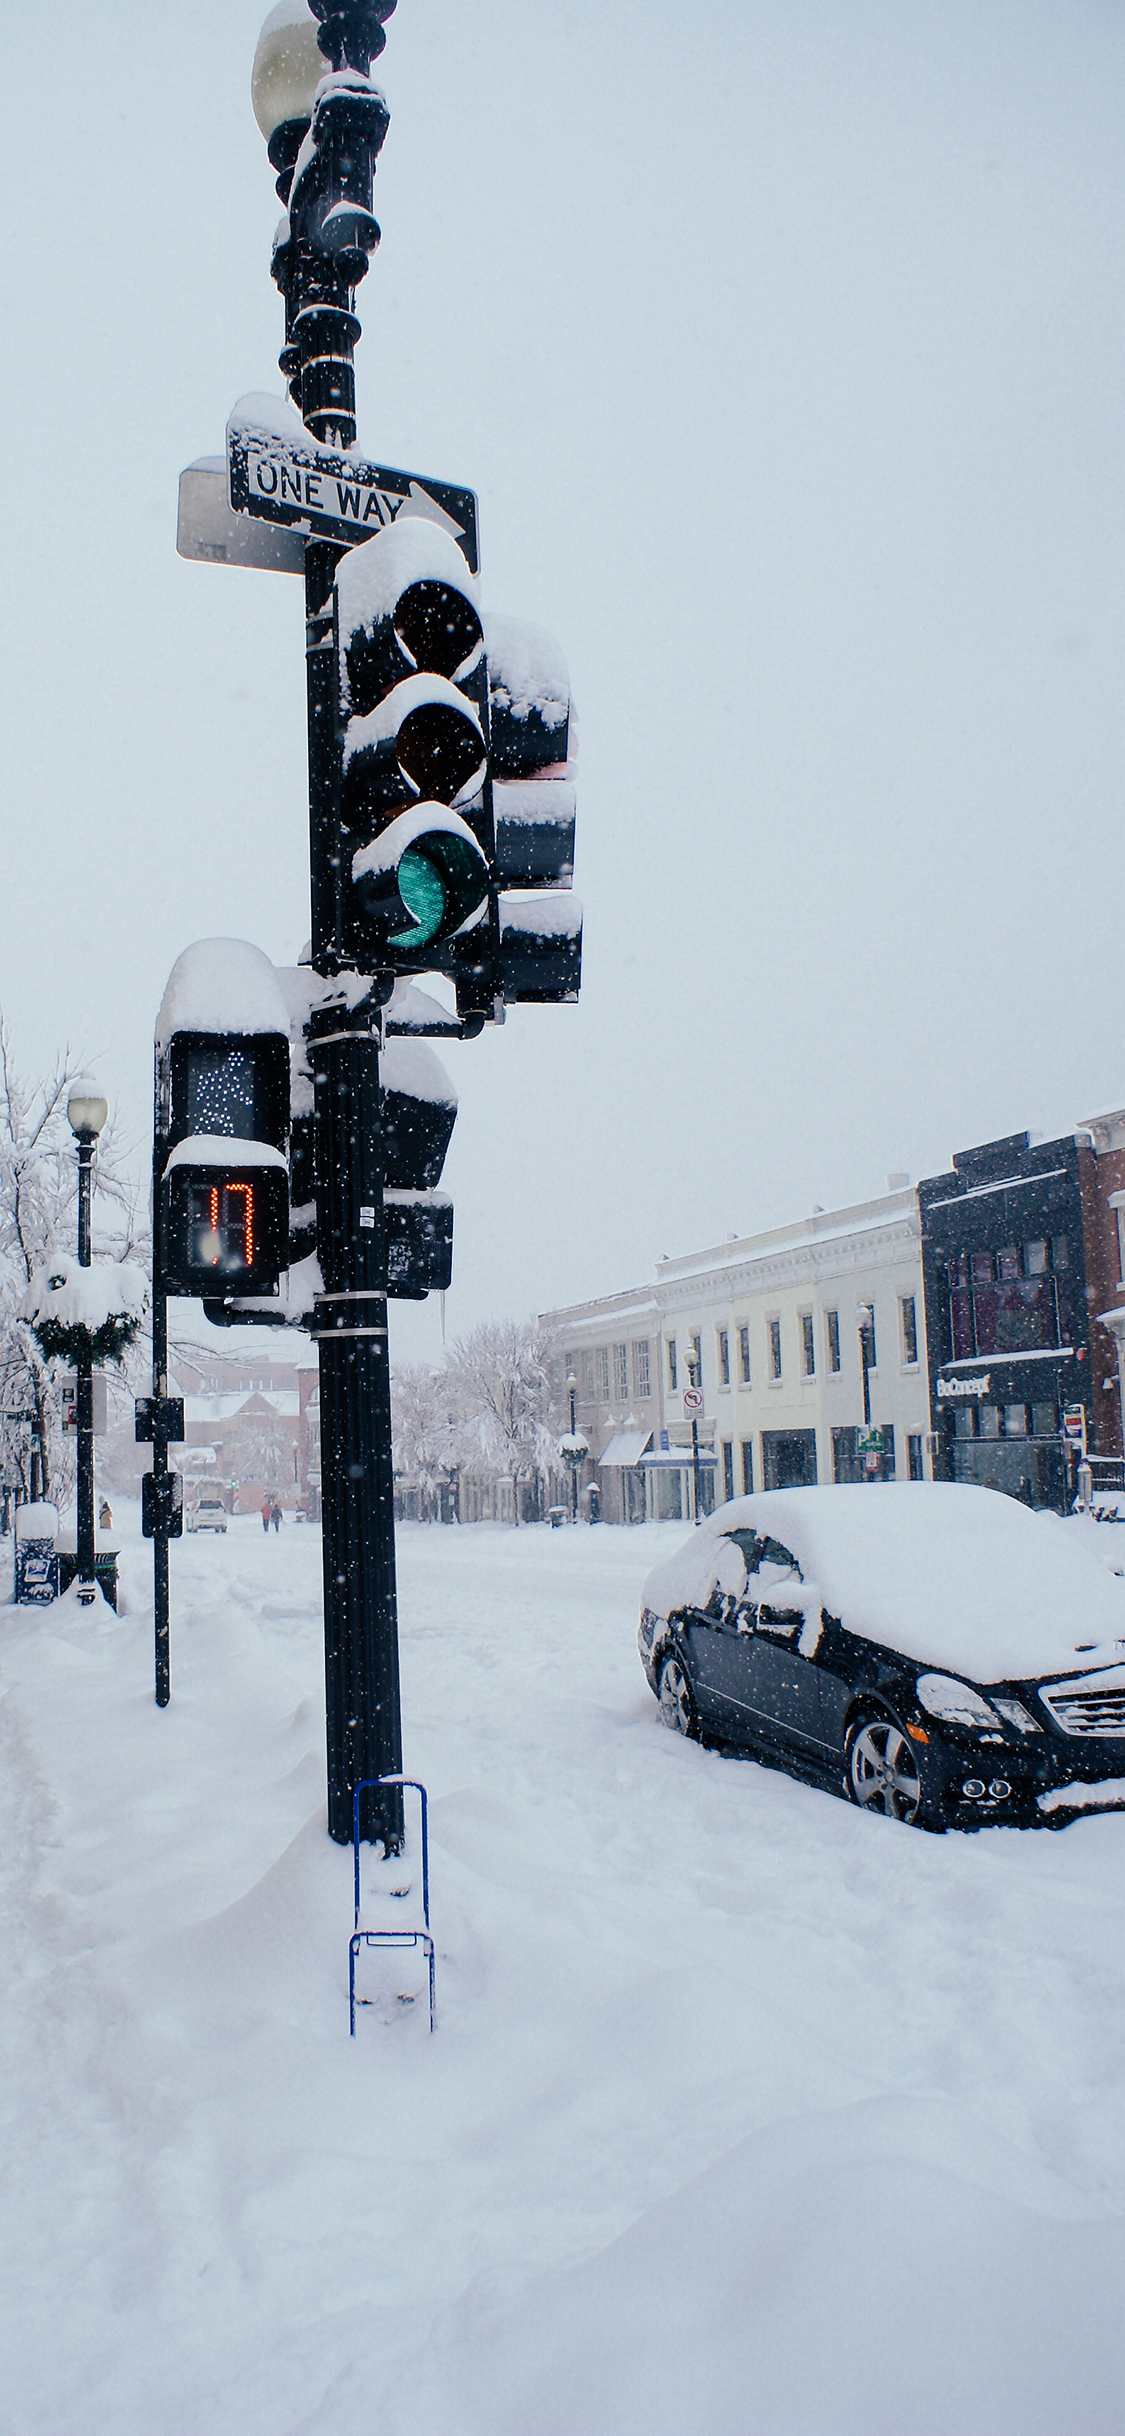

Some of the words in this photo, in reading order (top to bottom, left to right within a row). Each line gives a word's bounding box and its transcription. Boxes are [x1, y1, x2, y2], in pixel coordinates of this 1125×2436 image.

[257, 460, 324, 509] ONE
[336, 482, 404, 527] WAY
[211, 1184, 253, 1266] 17
